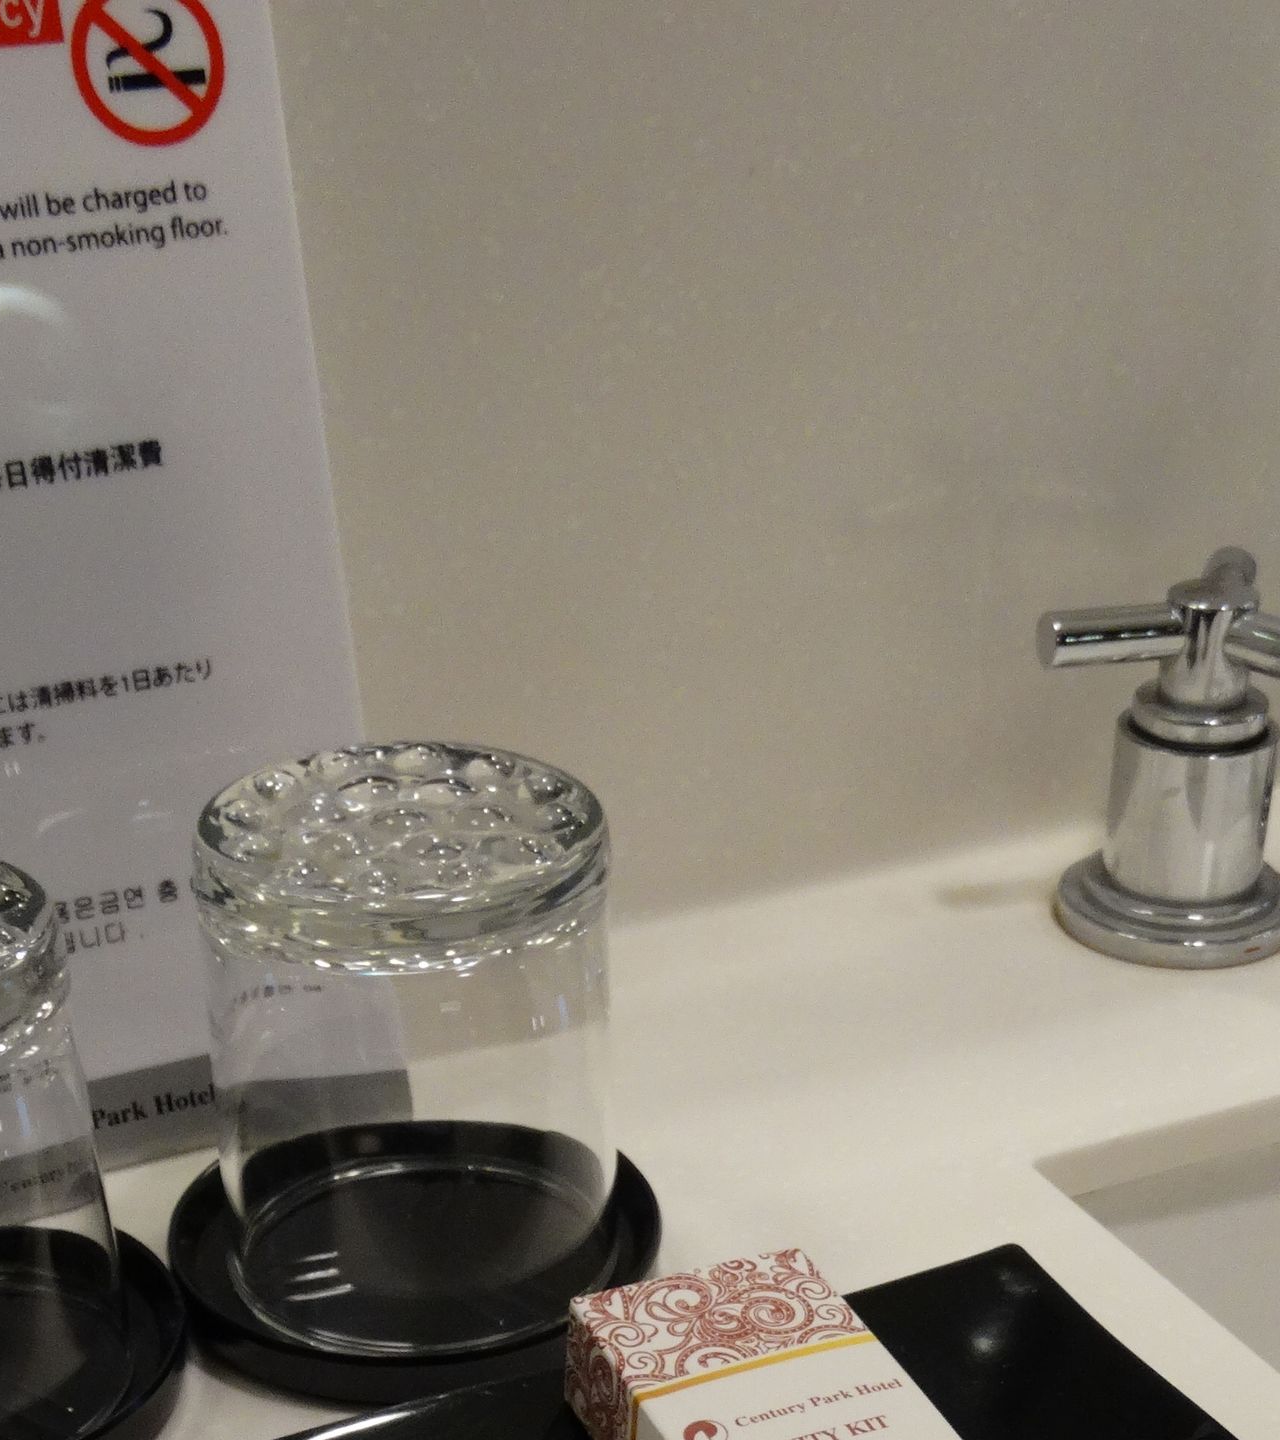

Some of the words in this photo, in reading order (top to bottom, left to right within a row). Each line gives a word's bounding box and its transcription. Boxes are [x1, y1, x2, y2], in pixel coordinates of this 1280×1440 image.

[45, 192, 76, 216] be
[82, 180, 176, 214] charged
[183, 182, 208, 202] to
[10, 222, 167, 259] non-smoking
[170, 216, 228, 242] floor.
[91, 1098, 149, 1132] Park
[153, 1084, 219, 1118] Hotel
[734, 1401, 806, 1429] Century
[809, 1389, 854, 1409] Park
[854, 1377, 904, 1397] Hotel
[844, 1414, 891, 1438] KIT
